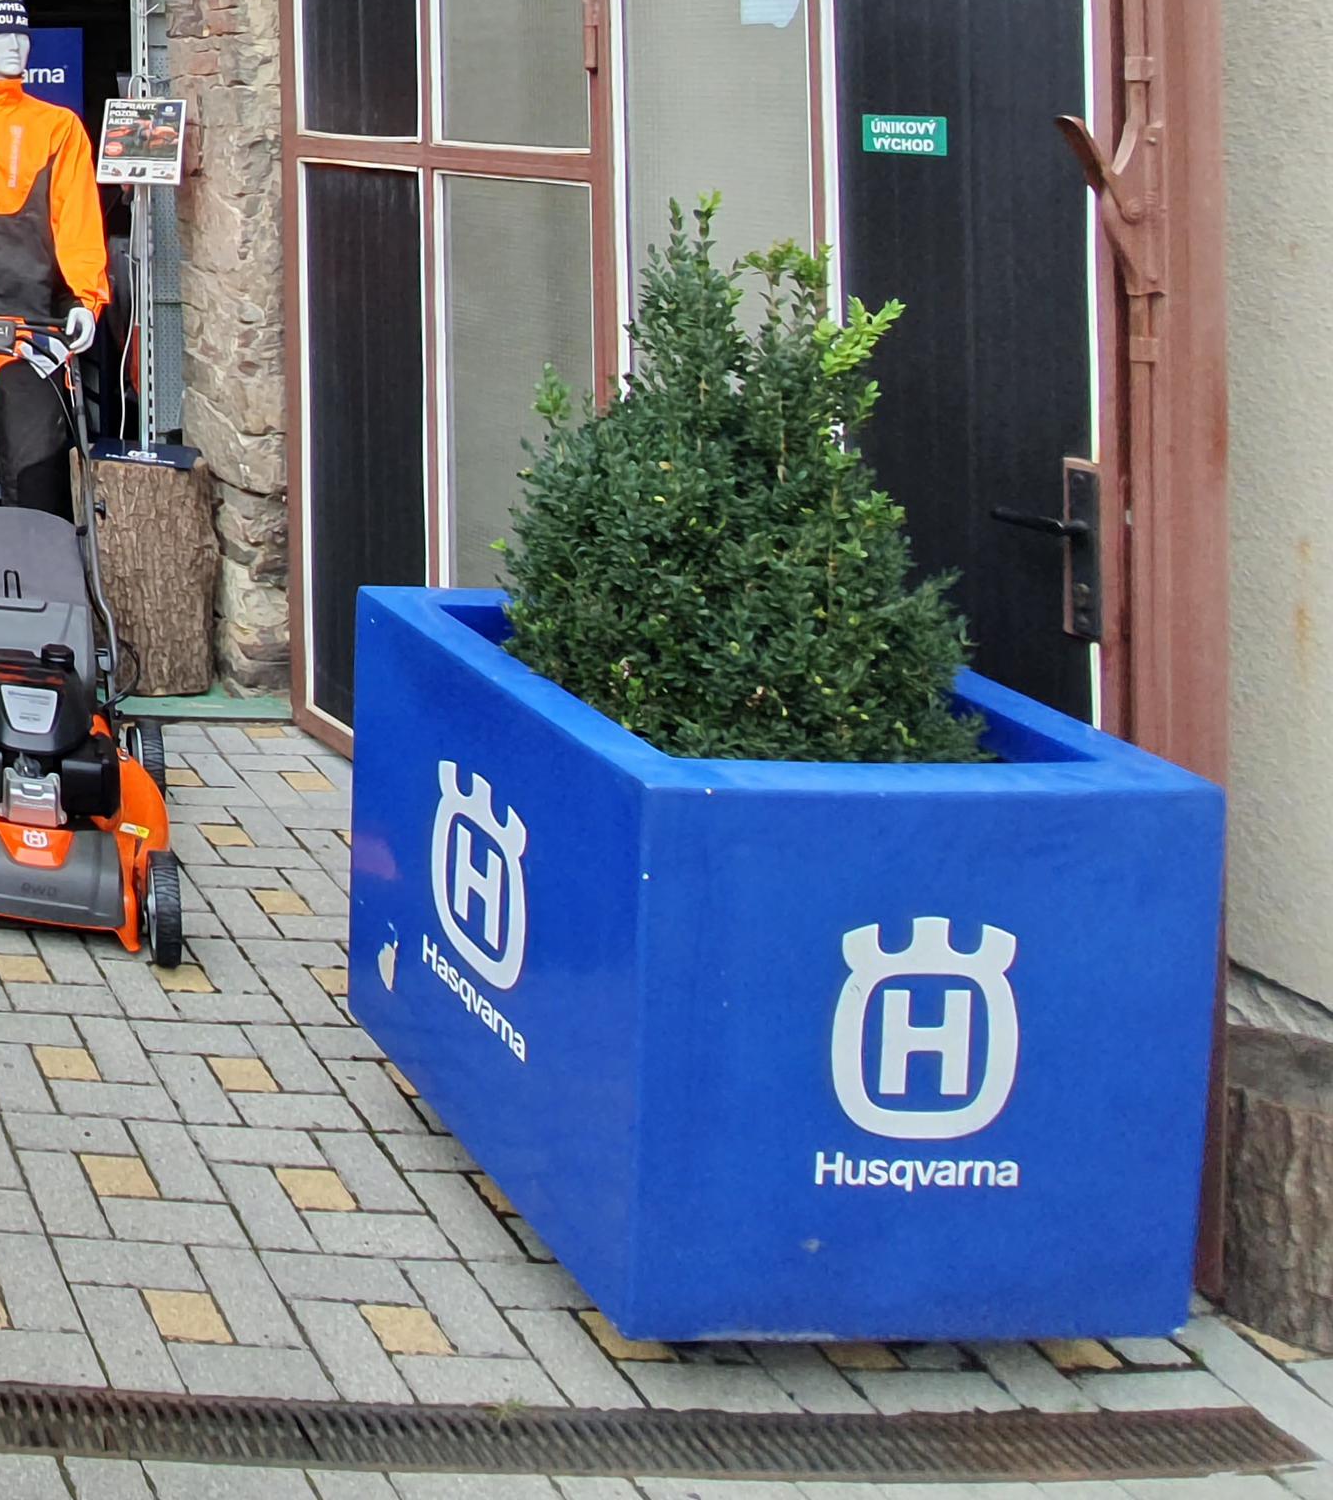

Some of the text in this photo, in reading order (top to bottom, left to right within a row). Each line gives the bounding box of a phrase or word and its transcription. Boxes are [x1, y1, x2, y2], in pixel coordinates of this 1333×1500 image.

[870, 118, 936, 135] ÚNIKOVÝ
[873, 135, 934, 152] VÝCHOD
[814, 1151, 1019, 1192] Husqvarna
